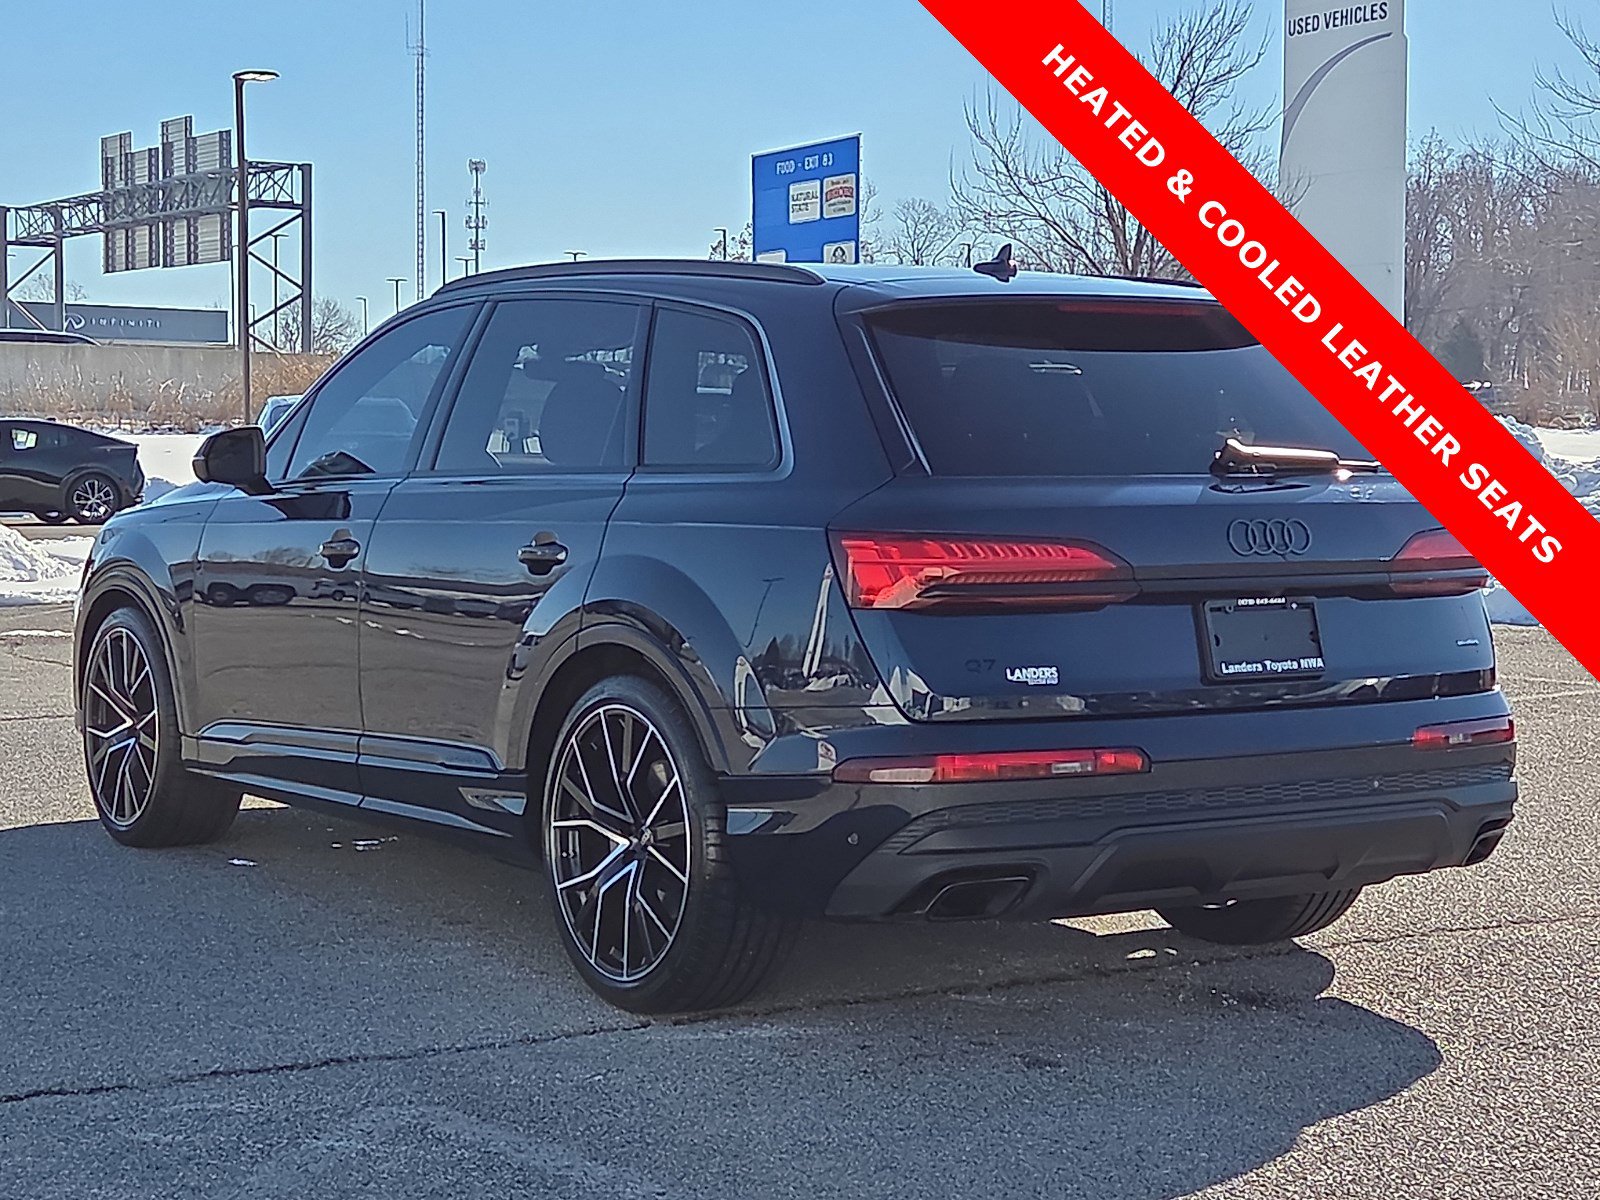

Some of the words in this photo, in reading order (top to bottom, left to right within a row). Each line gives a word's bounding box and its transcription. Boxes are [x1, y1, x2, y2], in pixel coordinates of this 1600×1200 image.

[1288, 15, 1320, 37] USED
[1324, 2, 1388, 30] VEHICLES
[776, 160, 795, 175] FOOD
[804, 155, 819, 170] EXIT
[90, 317, 161, 328] INFINITI
[965, 658, 996, 673] Q7
[1221, 661, 1263, 674] Landers
[1264, 659, 1298, 673] Toyota
[1299, 658, 1325, 669] NWA
[1006, 667, 1058, 681] LANDERS
